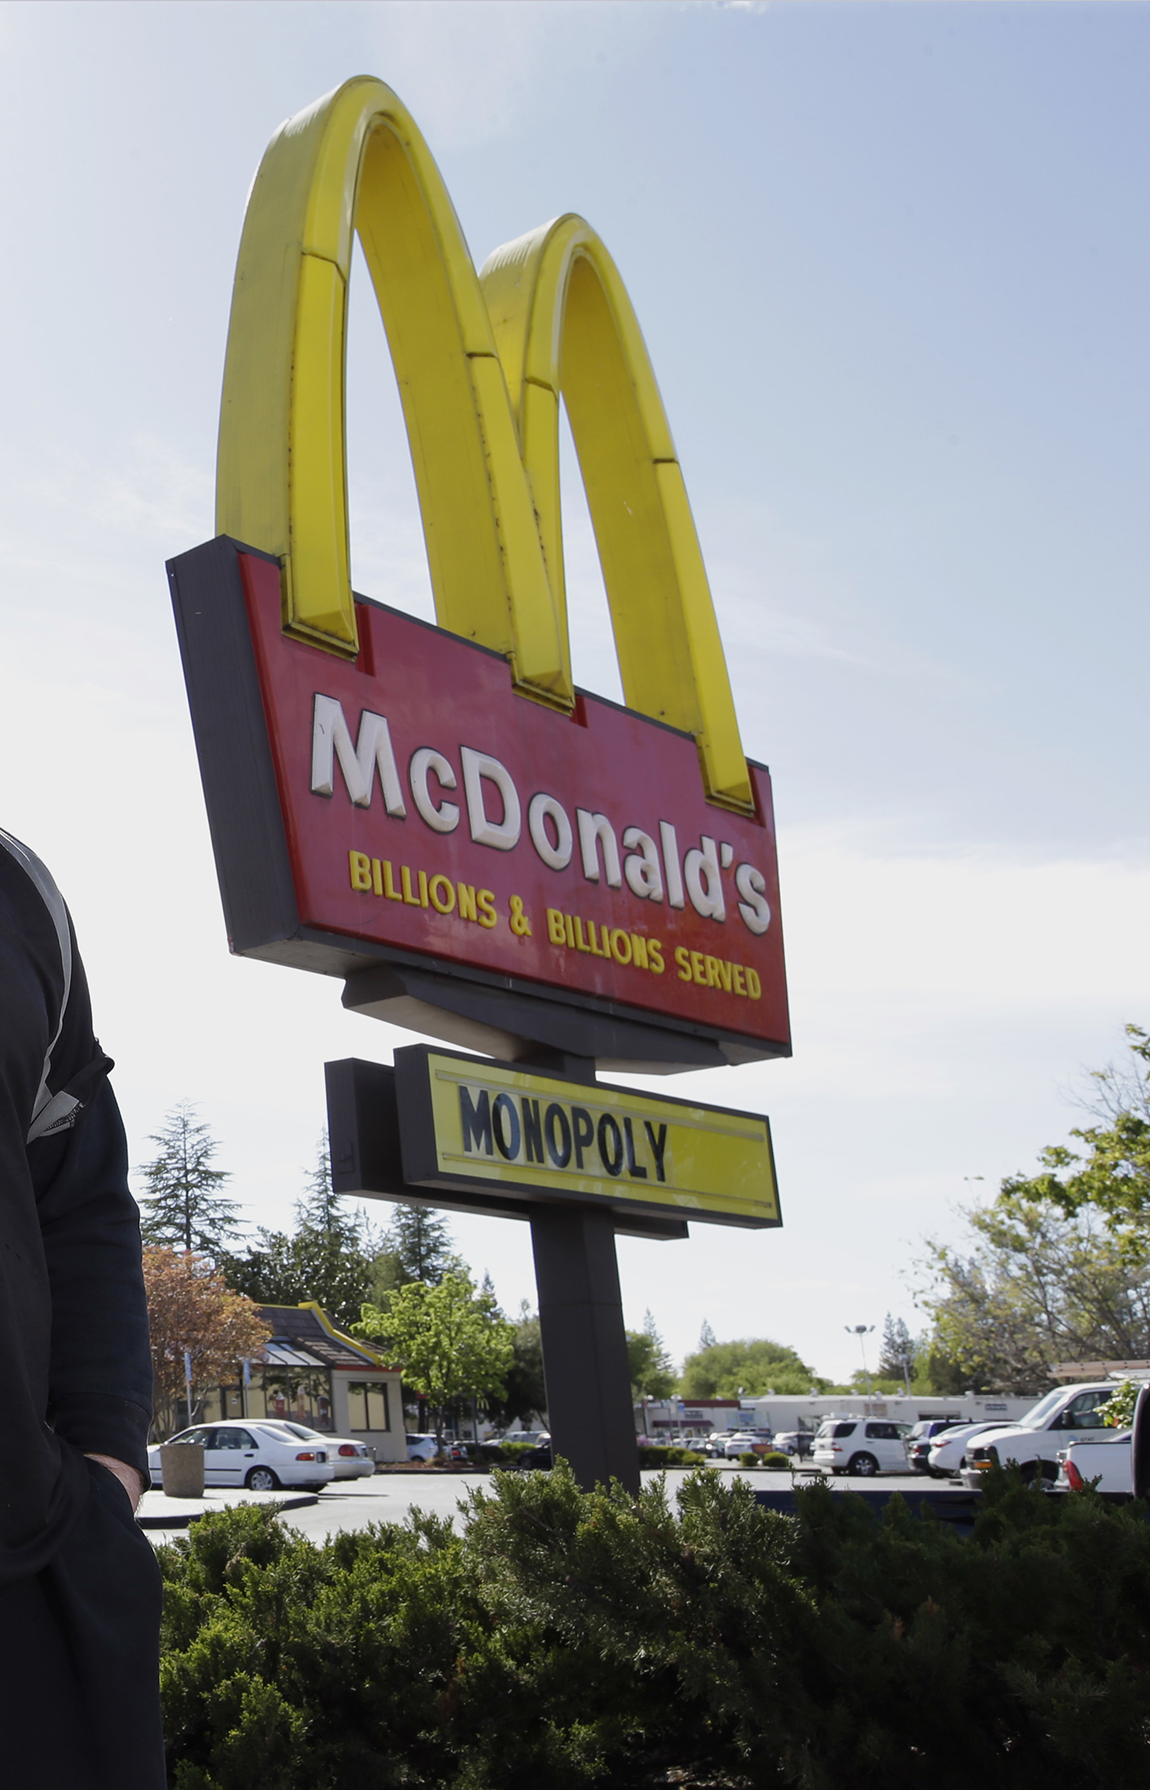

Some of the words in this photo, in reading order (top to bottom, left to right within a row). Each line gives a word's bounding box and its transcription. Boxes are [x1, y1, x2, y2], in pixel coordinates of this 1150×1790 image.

[310, 692, 771, 936] McDonald's
[349, 850, 498, 929] BILLIONS
[509, 894, 533, 938] &
[547, 907, 665, 975] BILLIONS
[675, 946, 762, 1000] SERVED
[458, 1083, 668, 1183] MONOPOLY
